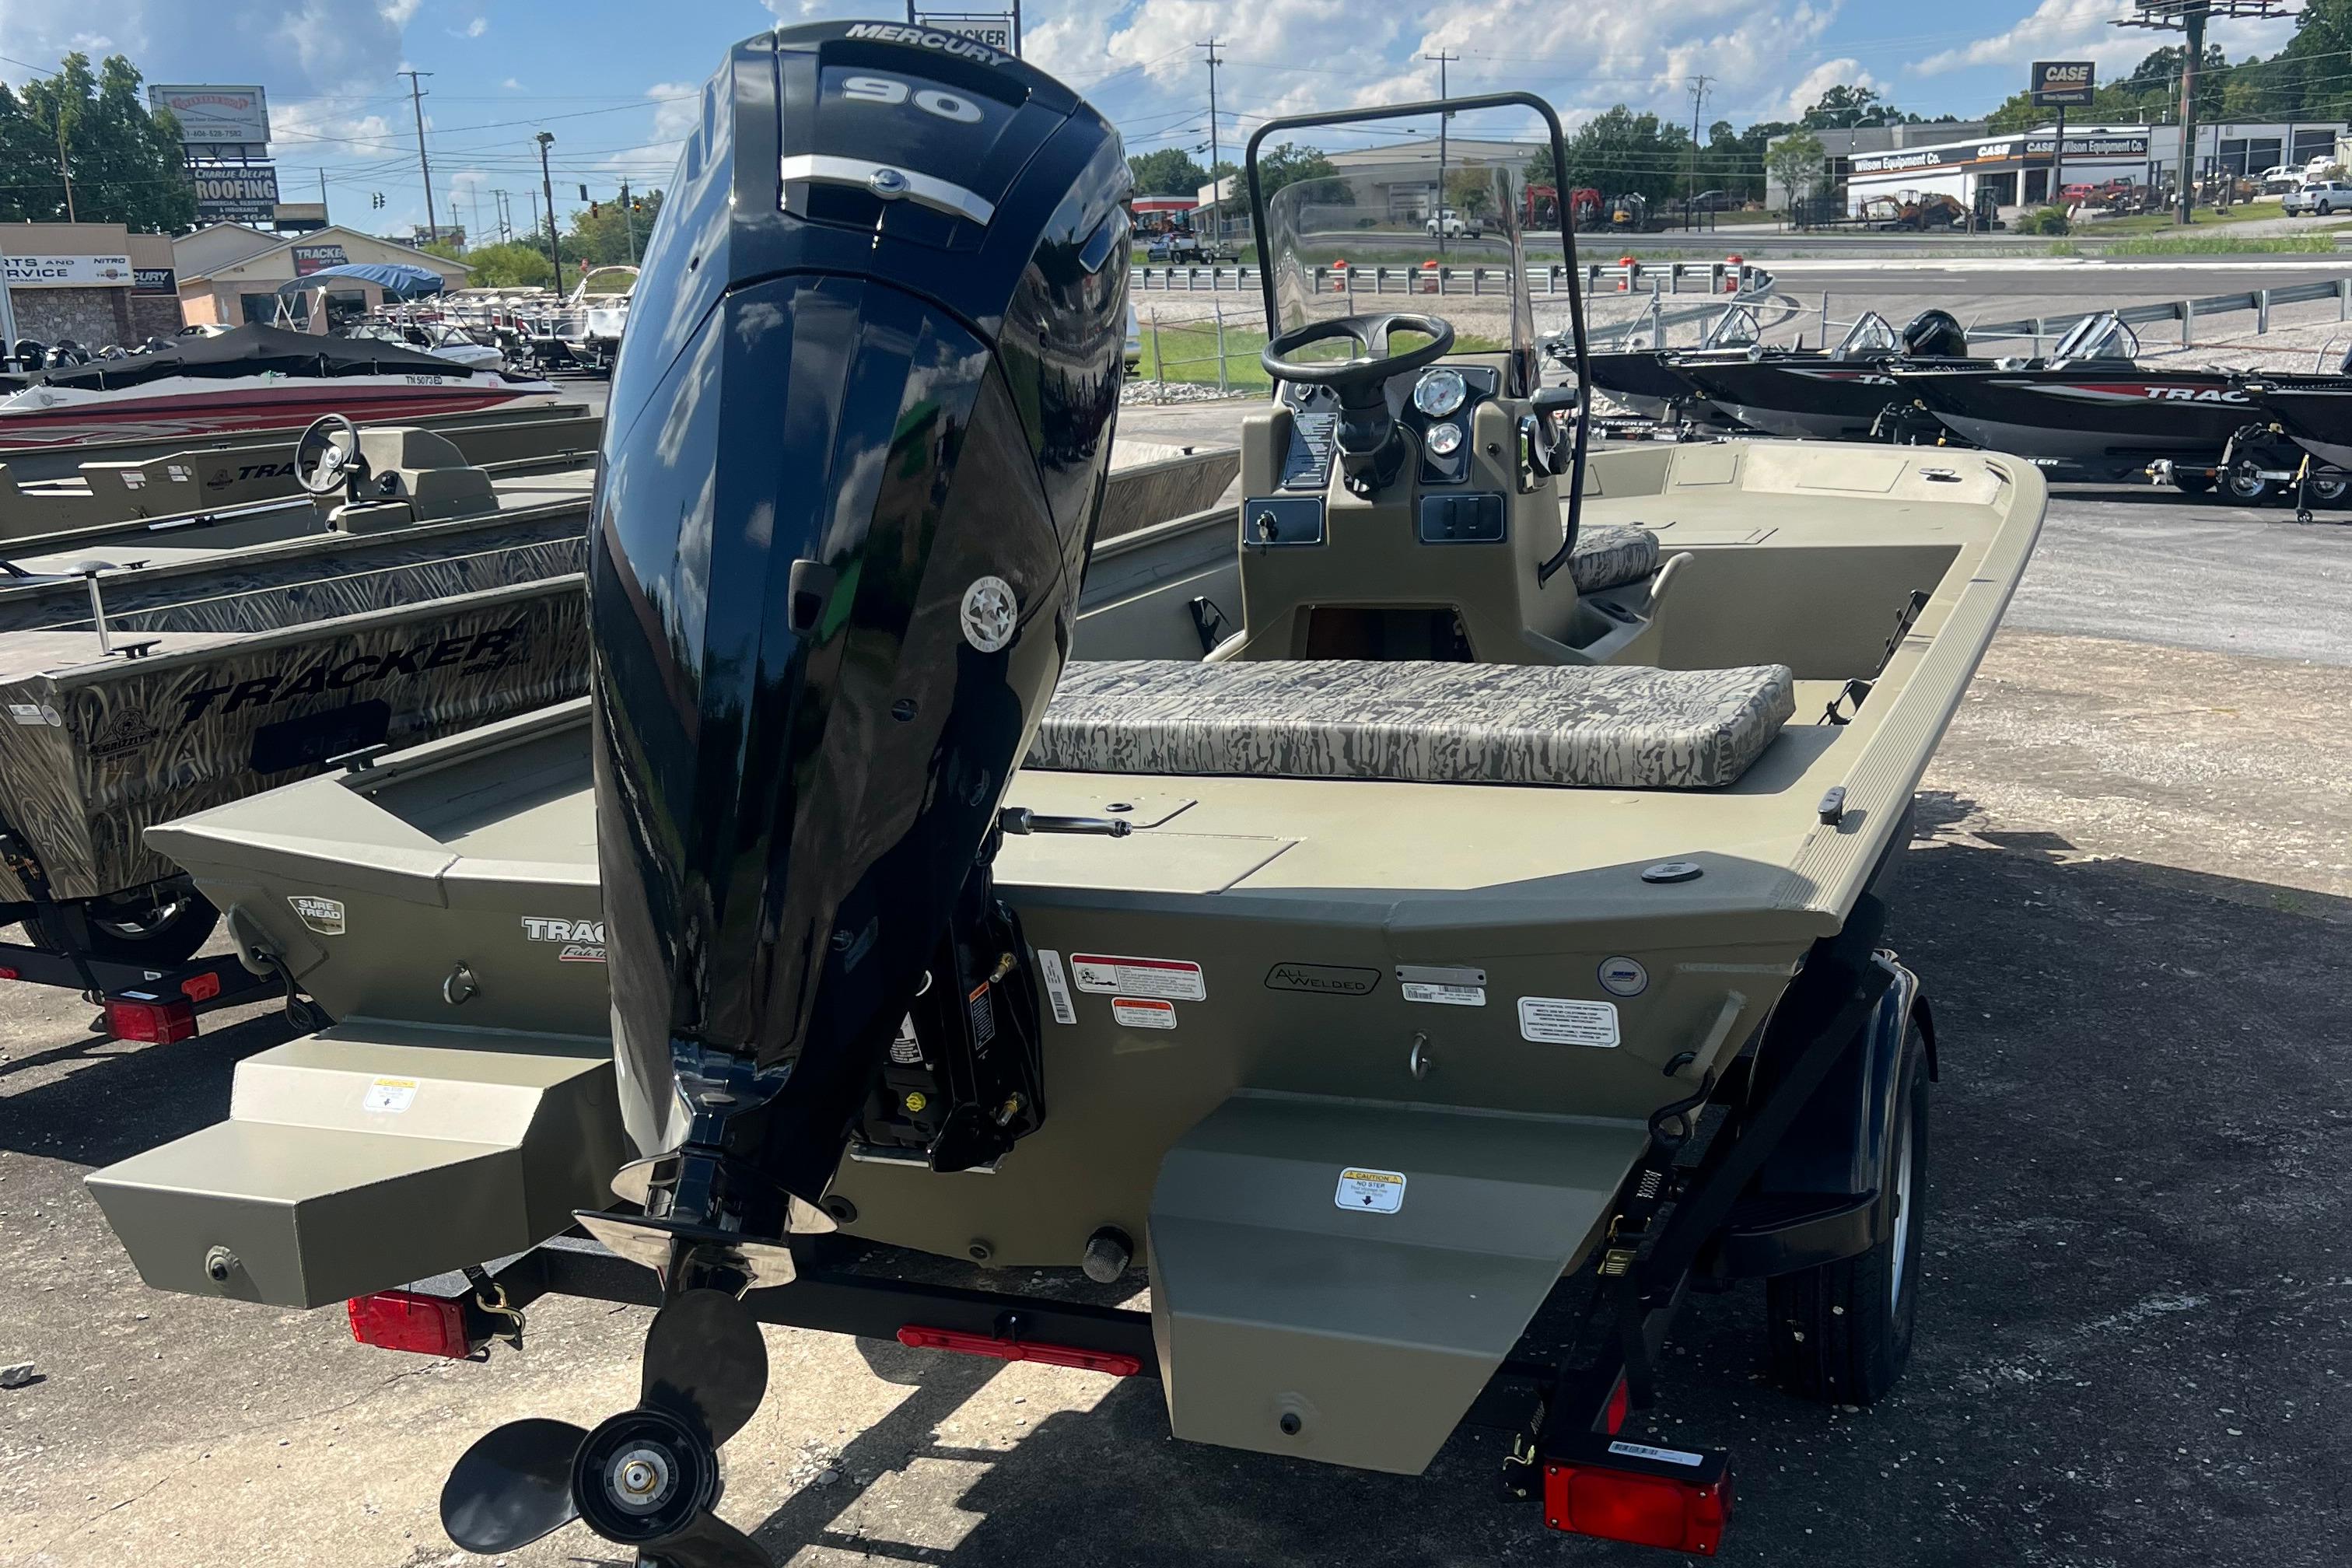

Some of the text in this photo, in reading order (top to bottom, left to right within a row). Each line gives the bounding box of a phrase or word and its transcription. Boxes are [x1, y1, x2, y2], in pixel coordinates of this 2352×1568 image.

[845, 23, 1014, 67] MERCURY
[2046, 66, 2089, 82] CASE
[841, 75, 984, 124] 90
[1977, 144, 2011, 157] CASE
[2026, 142, 2055, 152] CASE
[2061, 139, 2144, 156] Wilson Equipment Co.
[1854, 152, 1941, 173] Wilson Equipment Co.
[194, 180, 276, 199] ROOFING
[2144, 387, 2249, 403] TRAC
[181, 625, 516, 723] TRACKER
[298, 907, 341, 919] TREAD
[299, 899, 334, 911] SURE
[1276, 968, 1309, 979] ALL
[1286, 975, 1366, 990] WELDED
[1356, 1173, 1390, 1181] CAUTION
